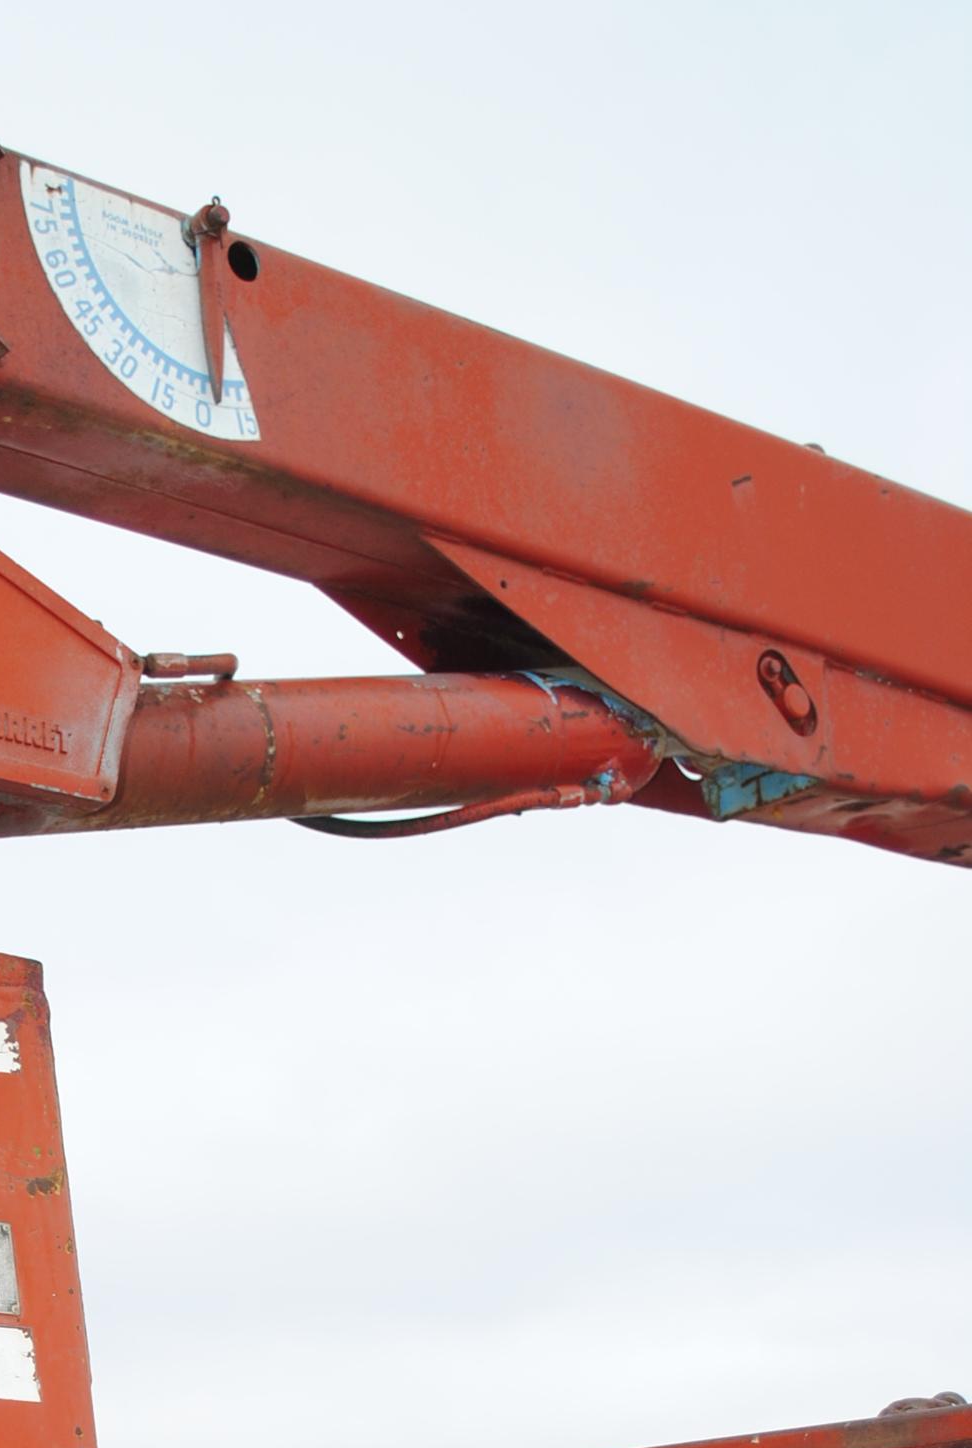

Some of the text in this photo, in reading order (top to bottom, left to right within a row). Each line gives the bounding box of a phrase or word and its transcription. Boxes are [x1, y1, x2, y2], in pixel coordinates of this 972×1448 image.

[29, 200, 258, 436] 75 60 45 30 15 0 15
